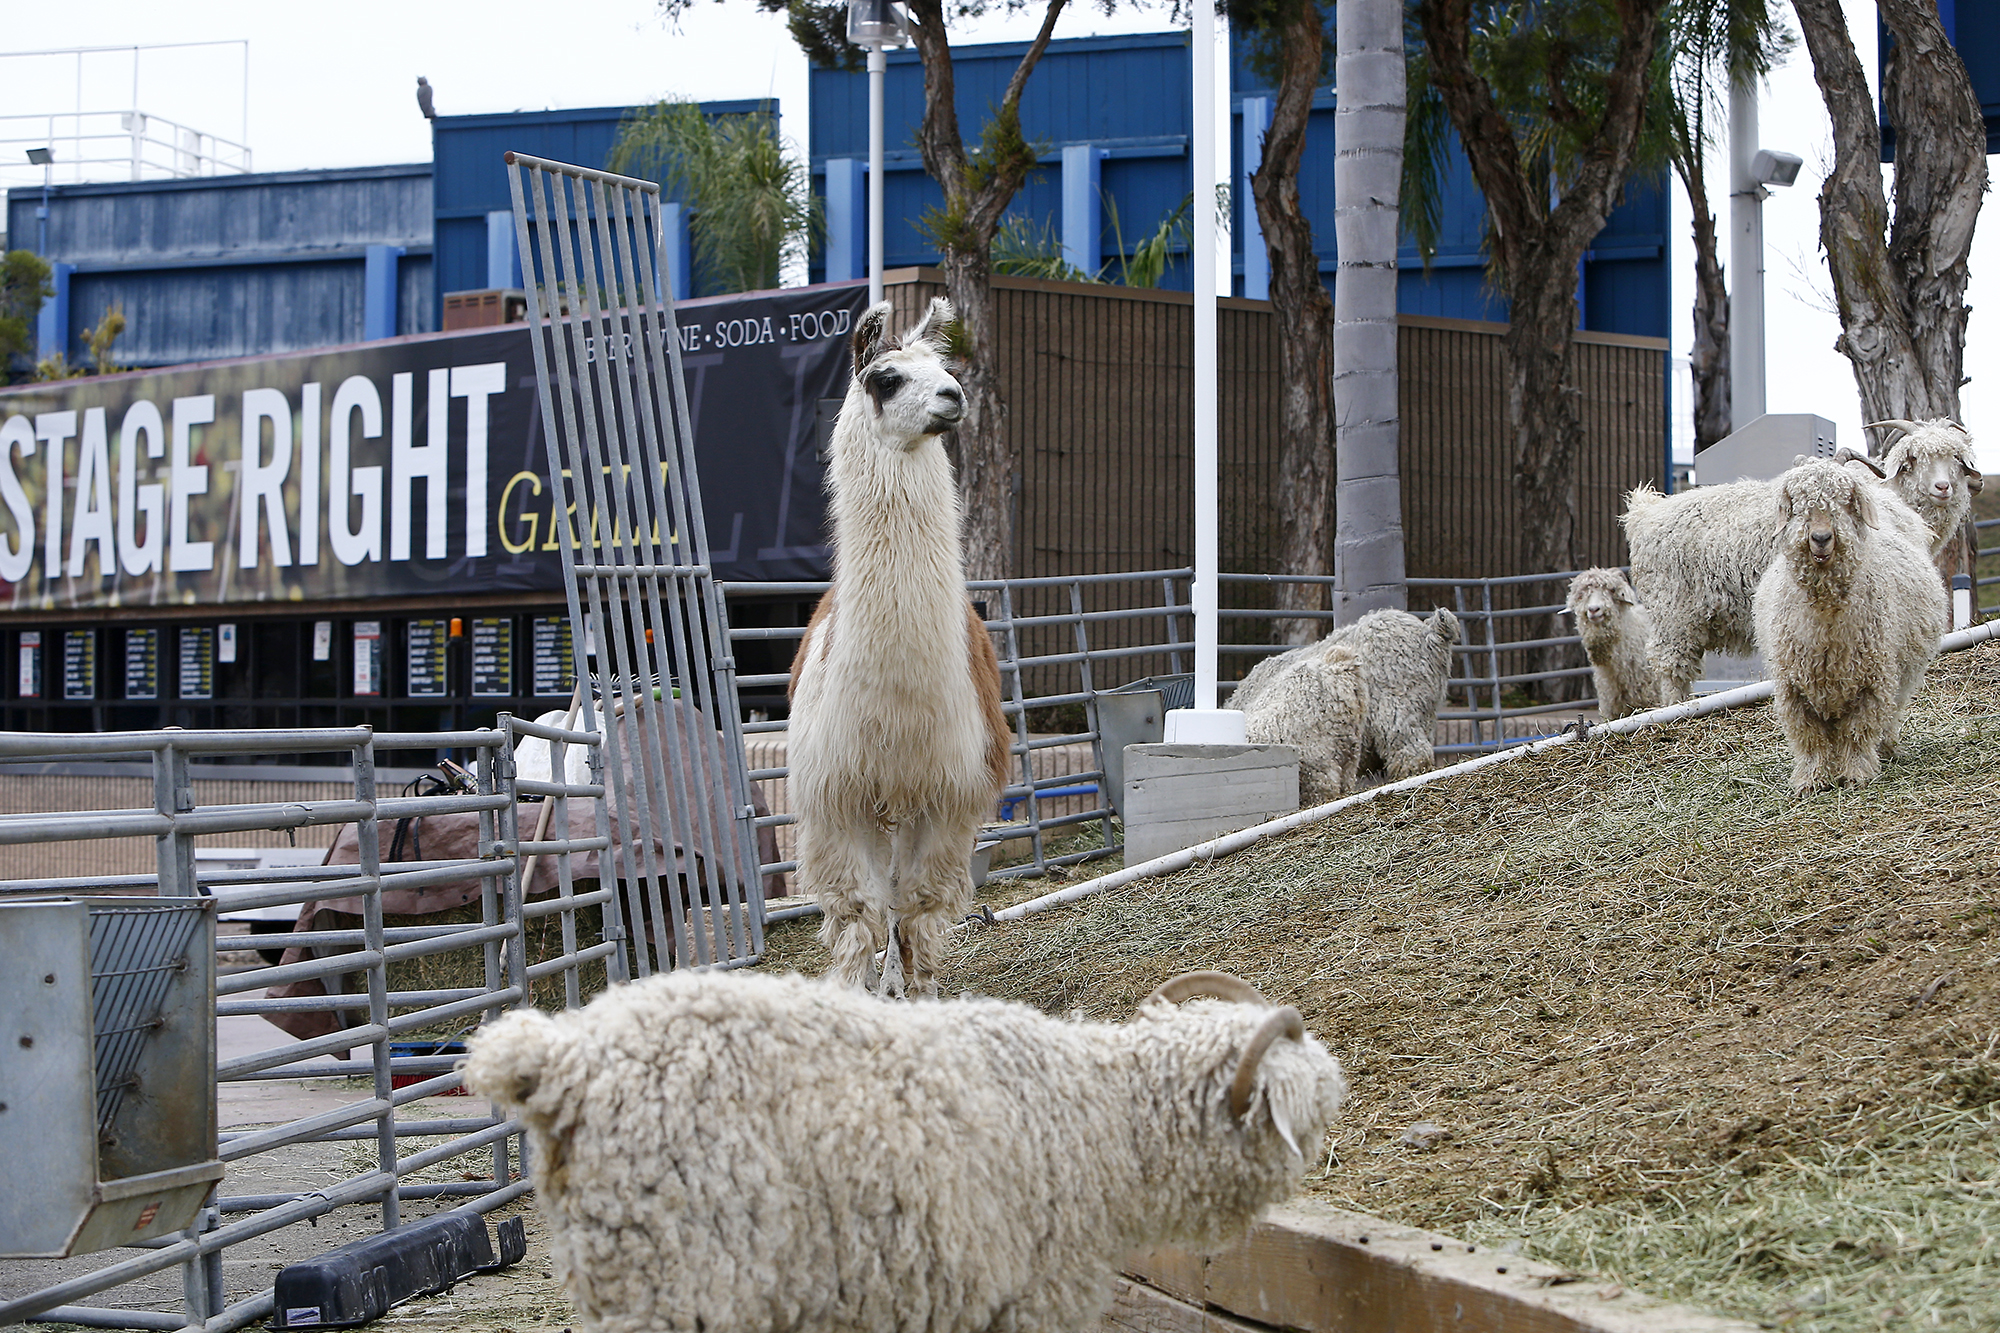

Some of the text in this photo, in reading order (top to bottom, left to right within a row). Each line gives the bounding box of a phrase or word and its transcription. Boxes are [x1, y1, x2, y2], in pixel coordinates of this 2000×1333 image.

[715, 316, 775, 349] SODA
[789, 309, 851, 342] FOOD
[0, 361, 507, 584] STAGE RIGHT
